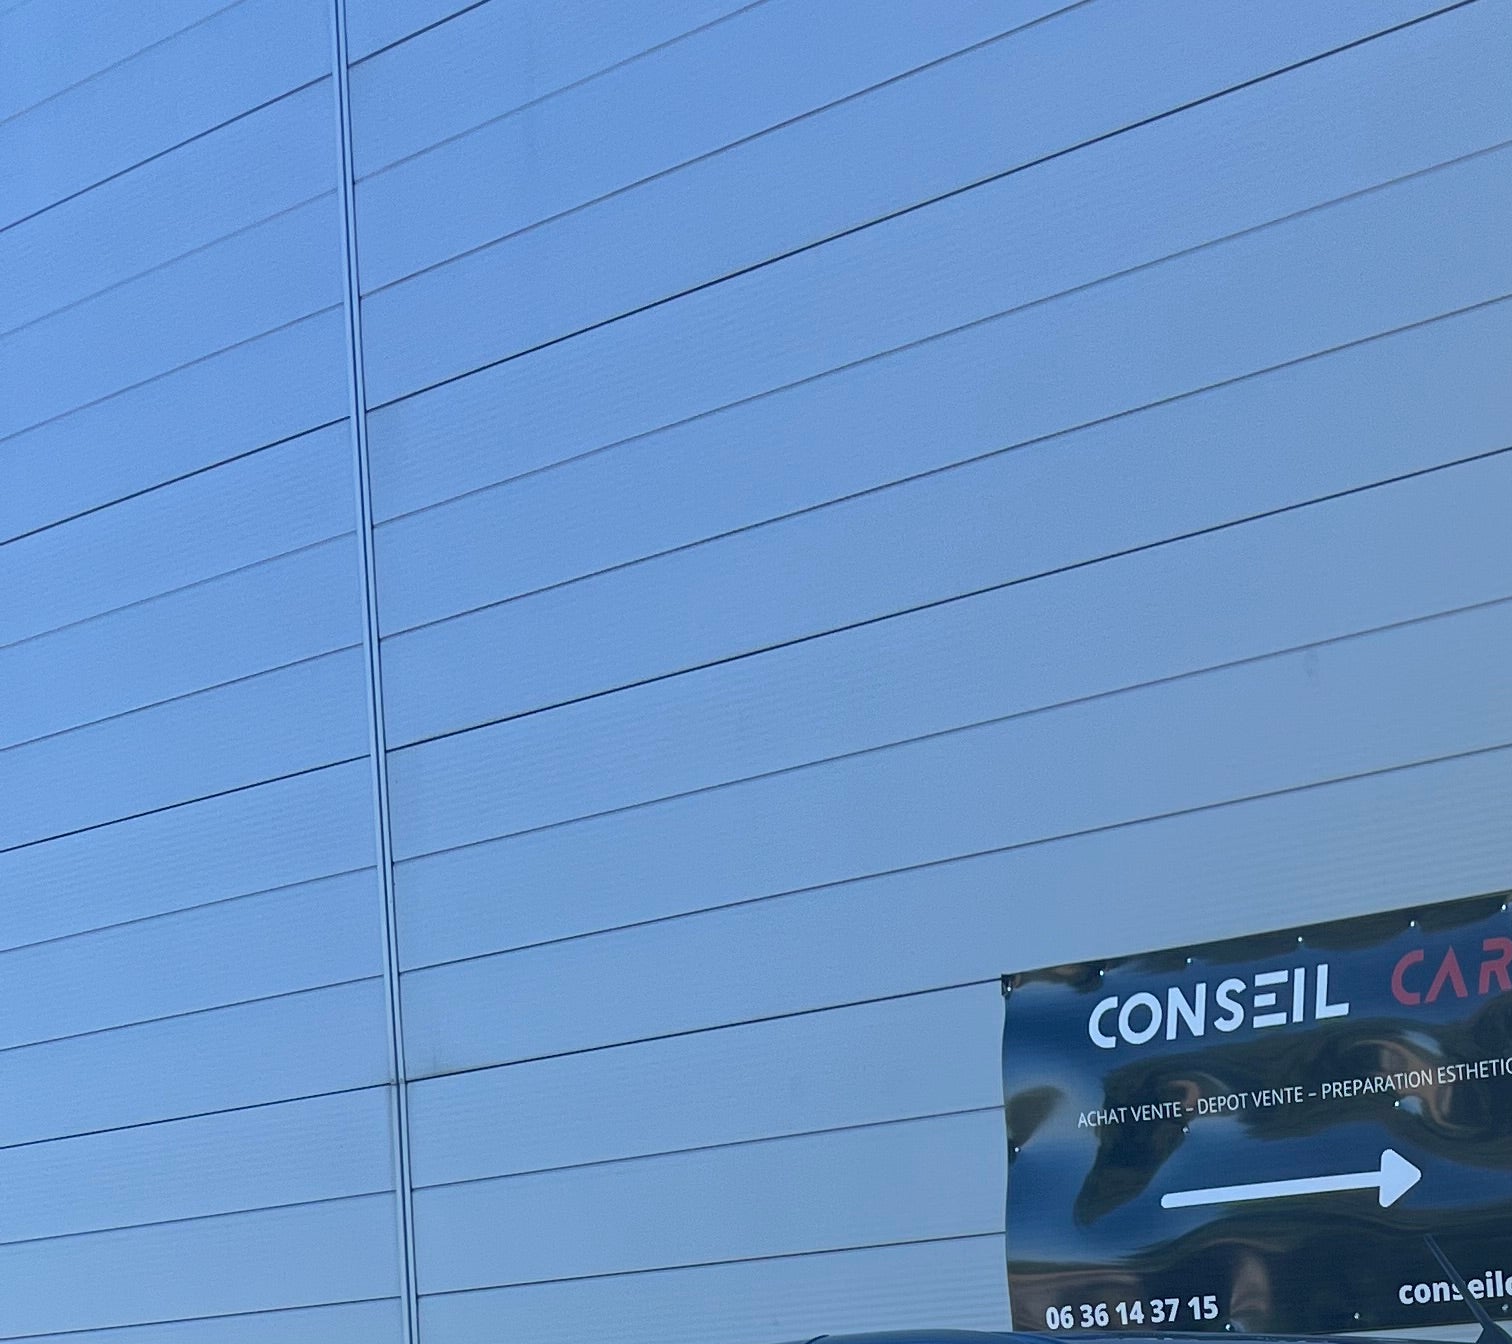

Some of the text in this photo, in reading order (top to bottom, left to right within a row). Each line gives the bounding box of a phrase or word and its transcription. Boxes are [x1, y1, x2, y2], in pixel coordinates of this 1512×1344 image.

[1088, 963, 1350, 1049] CONSEIL
[1077, 1107, 1127, 1129] ACHAT
[1131, 1101, 1182, 1122] VENTE
[1198, 1092, 1248, 1115] DEPOT
[1251, 1086, 1304, 1108] VENTE
[1321, 1068, 1433, 1100] PREPARATION
[1046, 1295, 1219, 1330] 06 36 14 37 15
